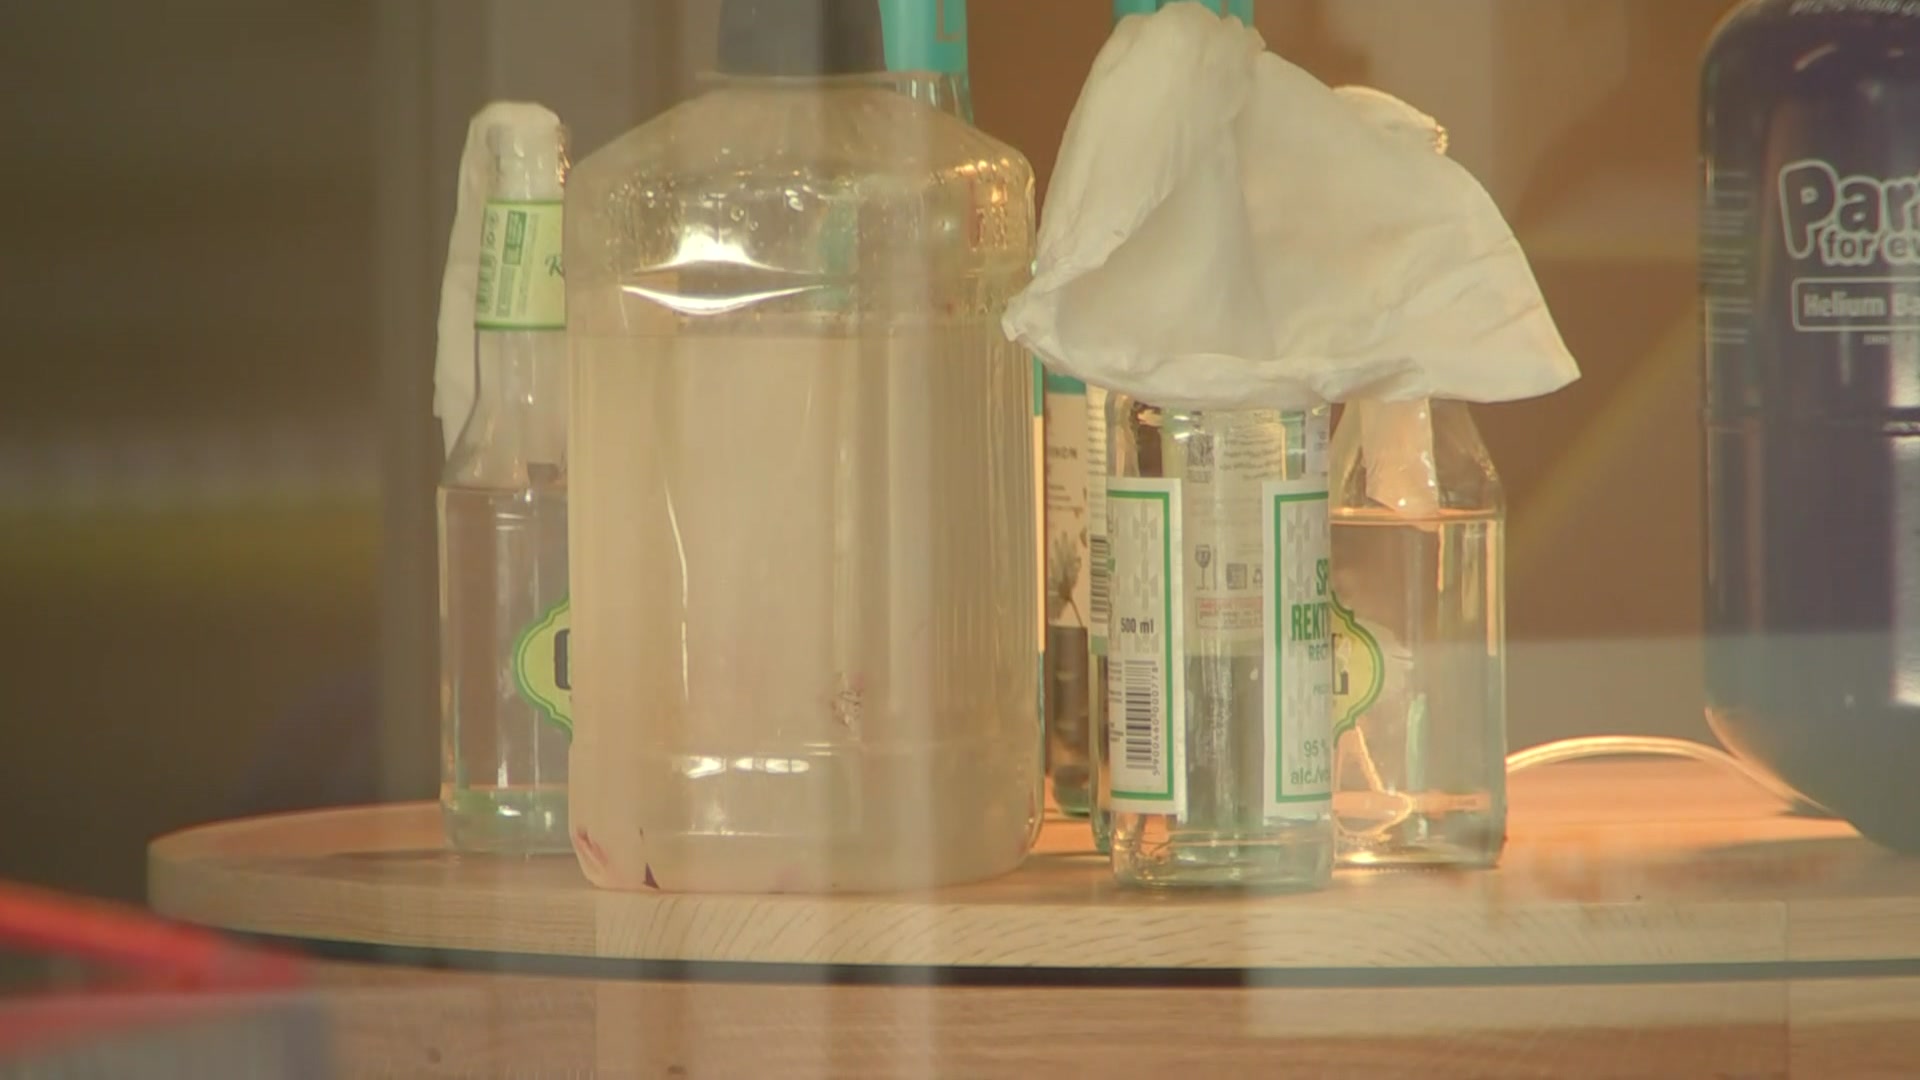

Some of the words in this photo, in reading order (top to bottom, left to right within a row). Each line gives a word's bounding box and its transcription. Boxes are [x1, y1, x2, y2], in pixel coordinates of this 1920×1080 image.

[1819, 225, 1880, 265] for
[1804, 291, 1886, 317] Helium
[1120, 617, 1136, 634] 500
[1139, 617, 1155, 634] ml
[1304, 740, 1319, 758] 95
